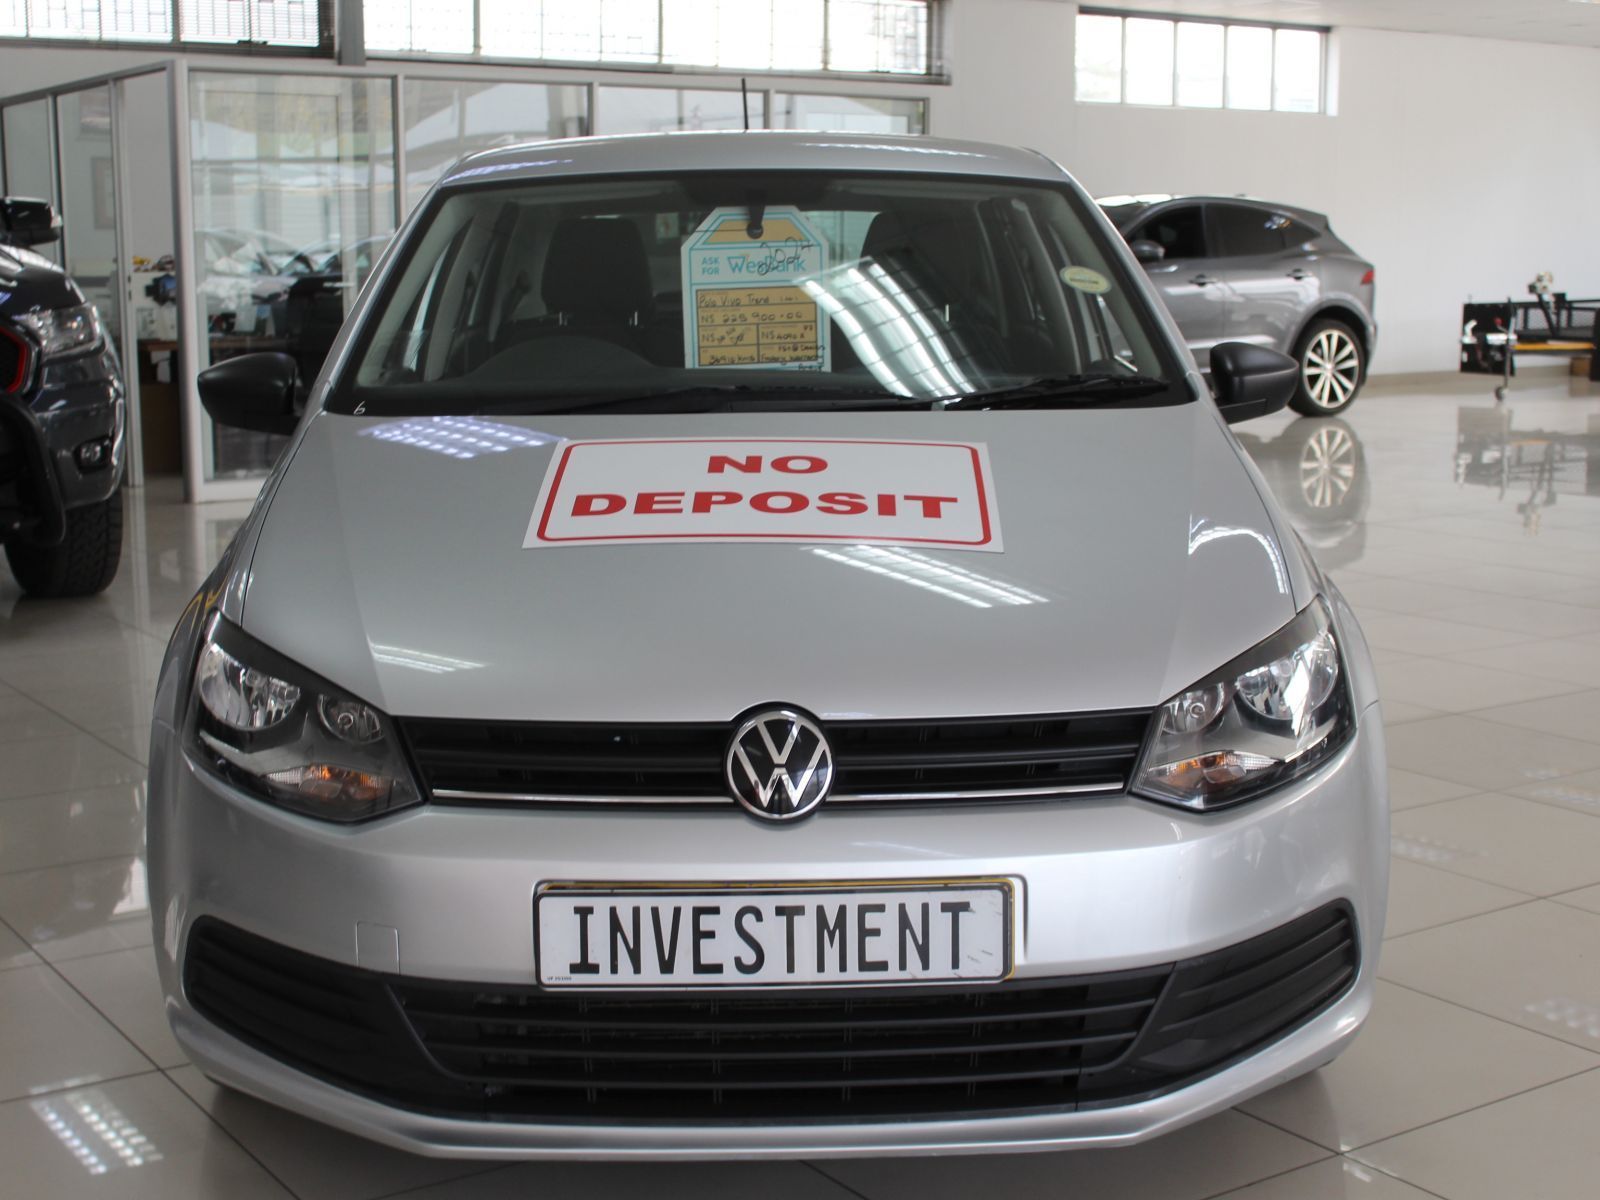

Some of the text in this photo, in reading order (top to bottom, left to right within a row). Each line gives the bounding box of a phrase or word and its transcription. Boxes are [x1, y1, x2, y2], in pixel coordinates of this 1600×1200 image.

[702, 256, 720, 266] ASK
[702, 267, 720, 276] FOR
[707, 455, 828, 474] NO
[571, 491, 958, 519] DEPOSIT
[569, 901, 971, 975] INVESTMENT
